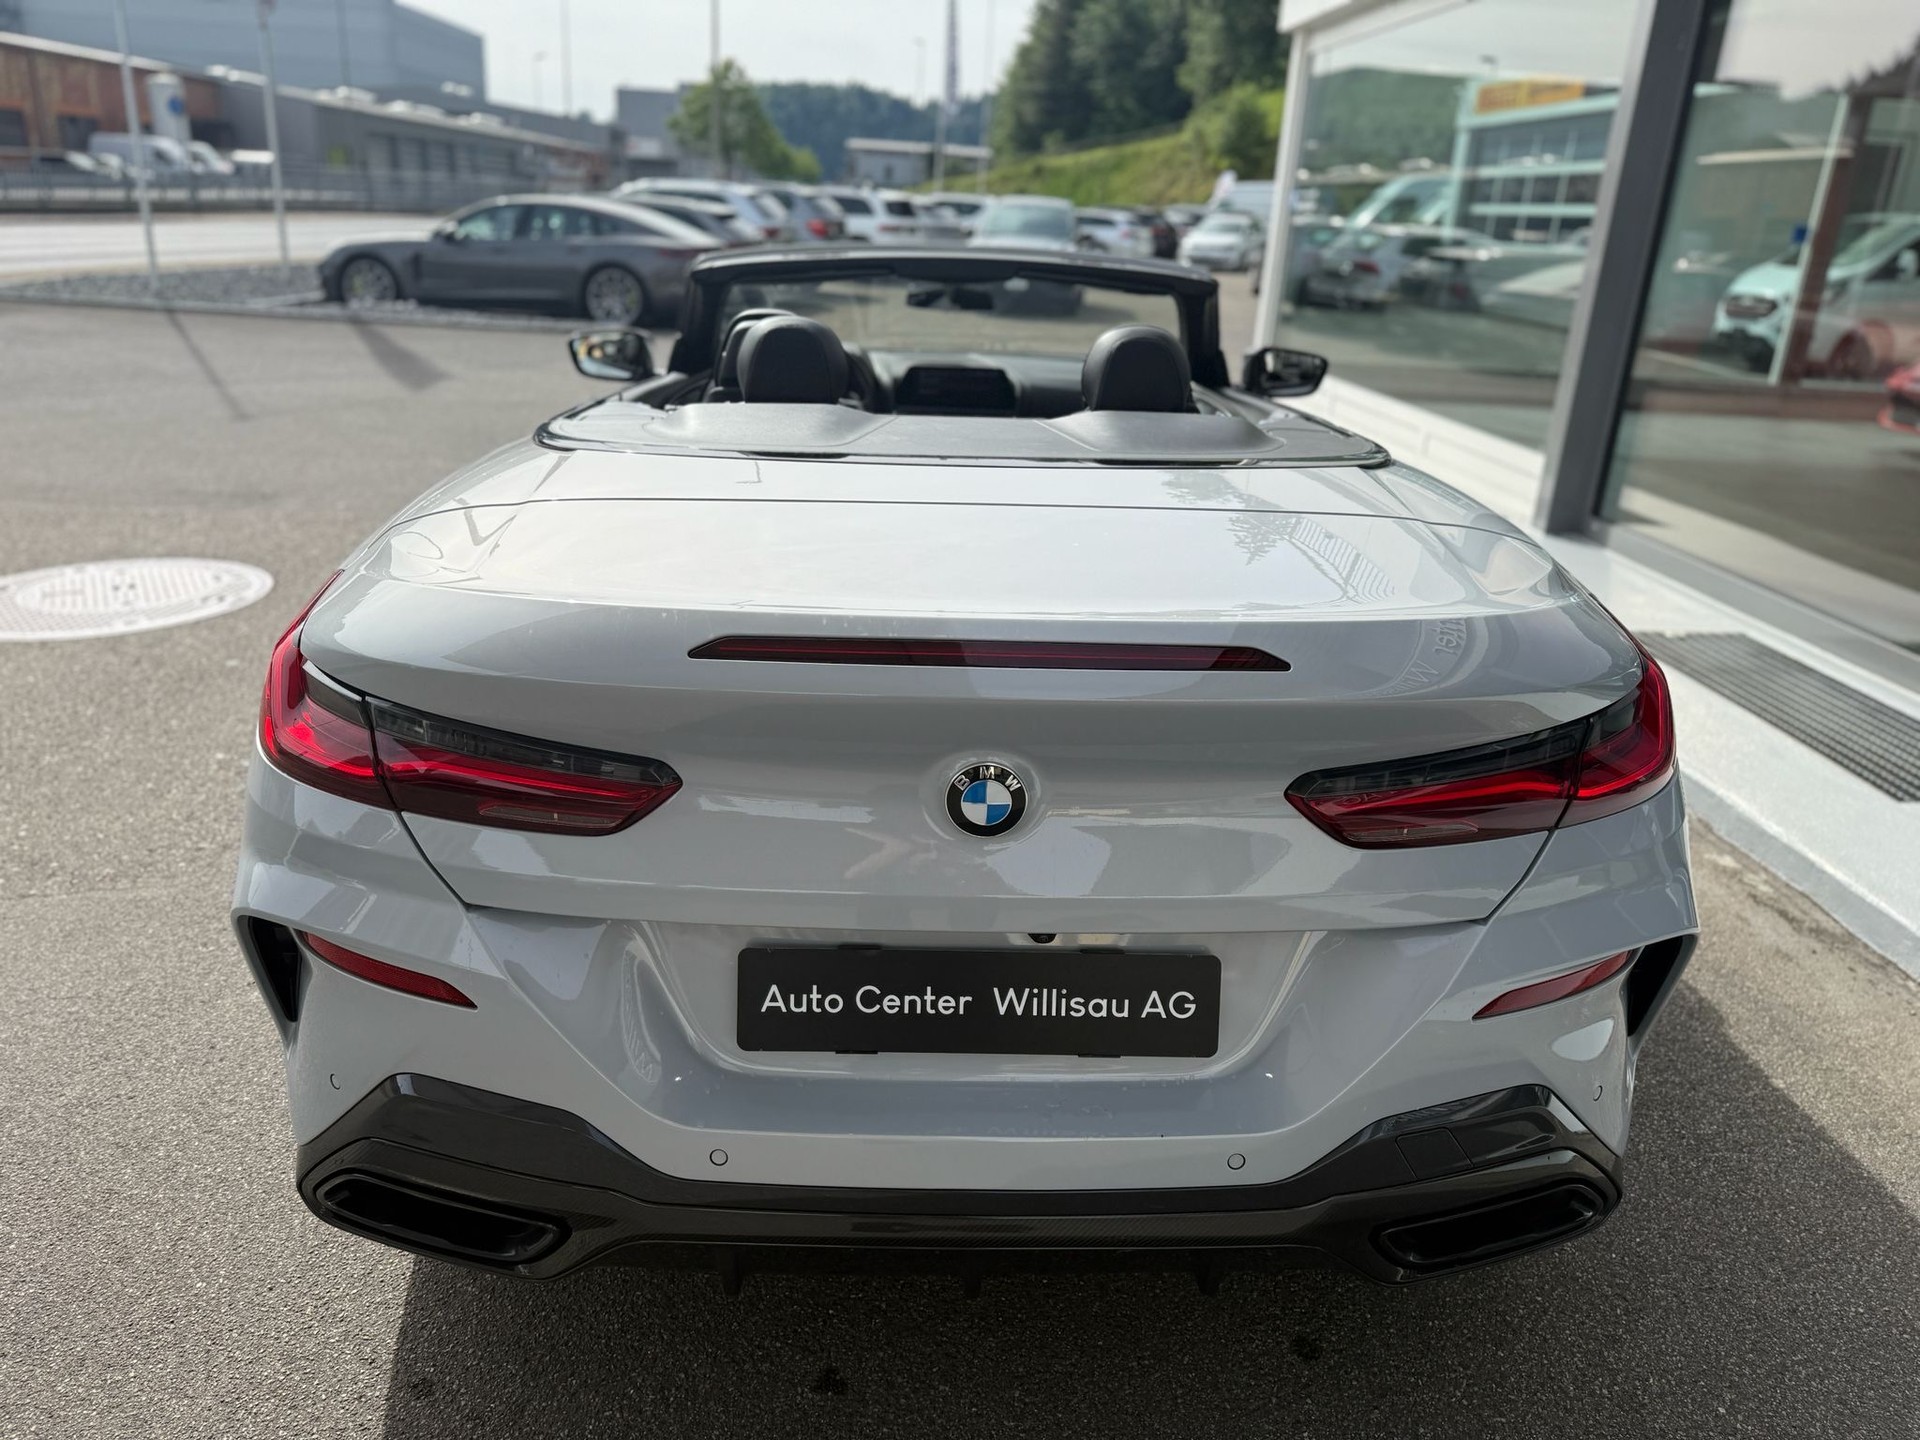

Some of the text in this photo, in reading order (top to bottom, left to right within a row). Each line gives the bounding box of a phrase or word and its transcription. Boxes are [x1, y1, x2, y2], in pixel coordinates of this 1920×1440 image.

[953, 766, 1021, 792] BMW
[760, 984, 1197, 1019] Auto Center Willisau AG
